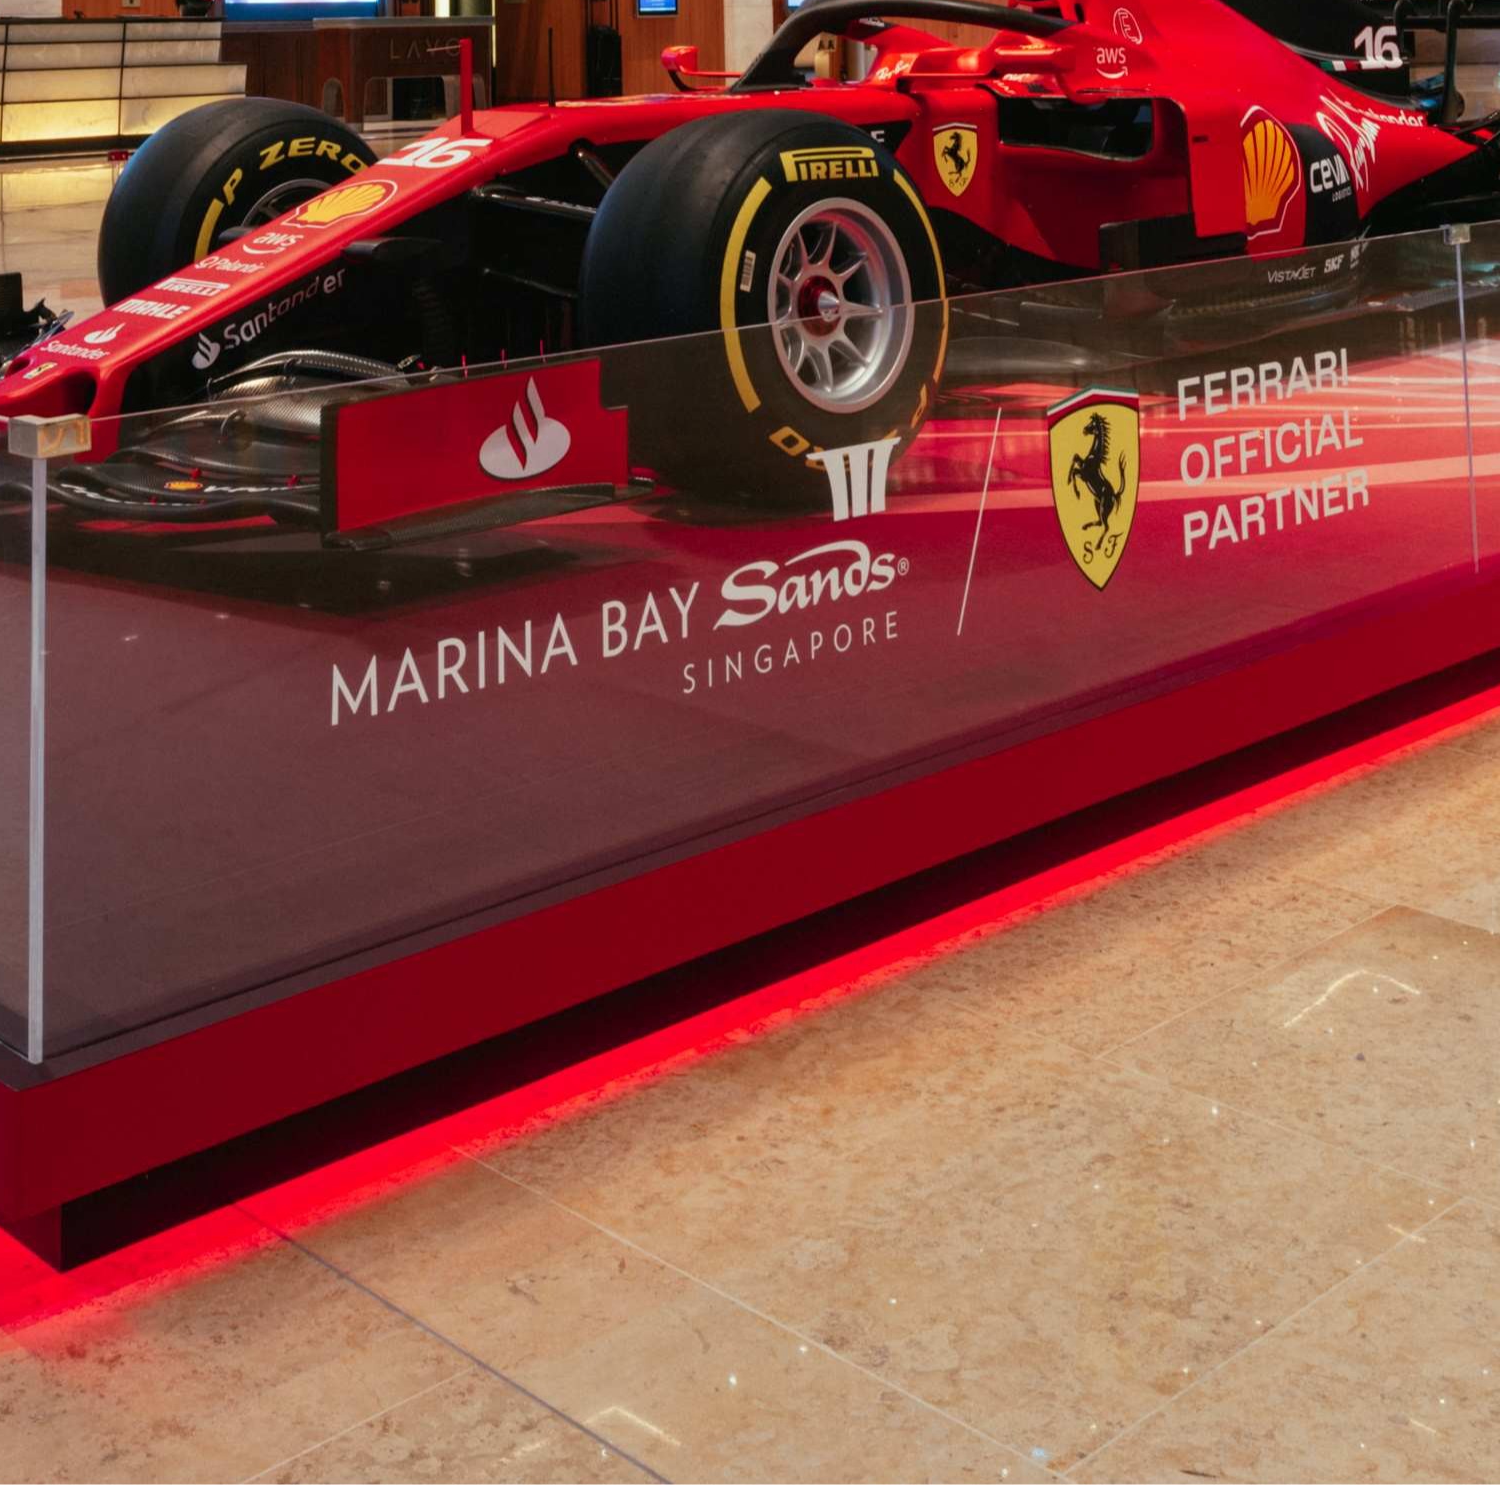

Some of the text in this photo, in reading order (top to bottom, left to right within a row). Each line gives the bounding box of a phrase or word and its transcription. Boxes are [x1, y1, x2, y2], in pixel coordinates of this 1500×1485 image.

[1097, 47, 1126, 65] aws
[1354, 25, 1403, 70] 16
[260, 136, 369, 176] ZERO
[376, 137, 493, 168] 16
[779, 146, 879, 182] PIRELLI
[253, 232, 304, 247] aws
[154, 277, 231, 296] PIRELLI
[112, 299, 191, 320] MAHLE
[224, 268, 346, 350] Santander
[40, 339, 110, 360] Santander
[1177, 348, 1349, 421] FERRARI
[1180, 409, 1364, 487] OFFICIAL
[1183, 467, 1369, 557] PARTNER
[331, 612, 578, 726] MARINA
[601, 581, 699, 657] BAY
[683, 610, 899, 694] SINGAPORE
